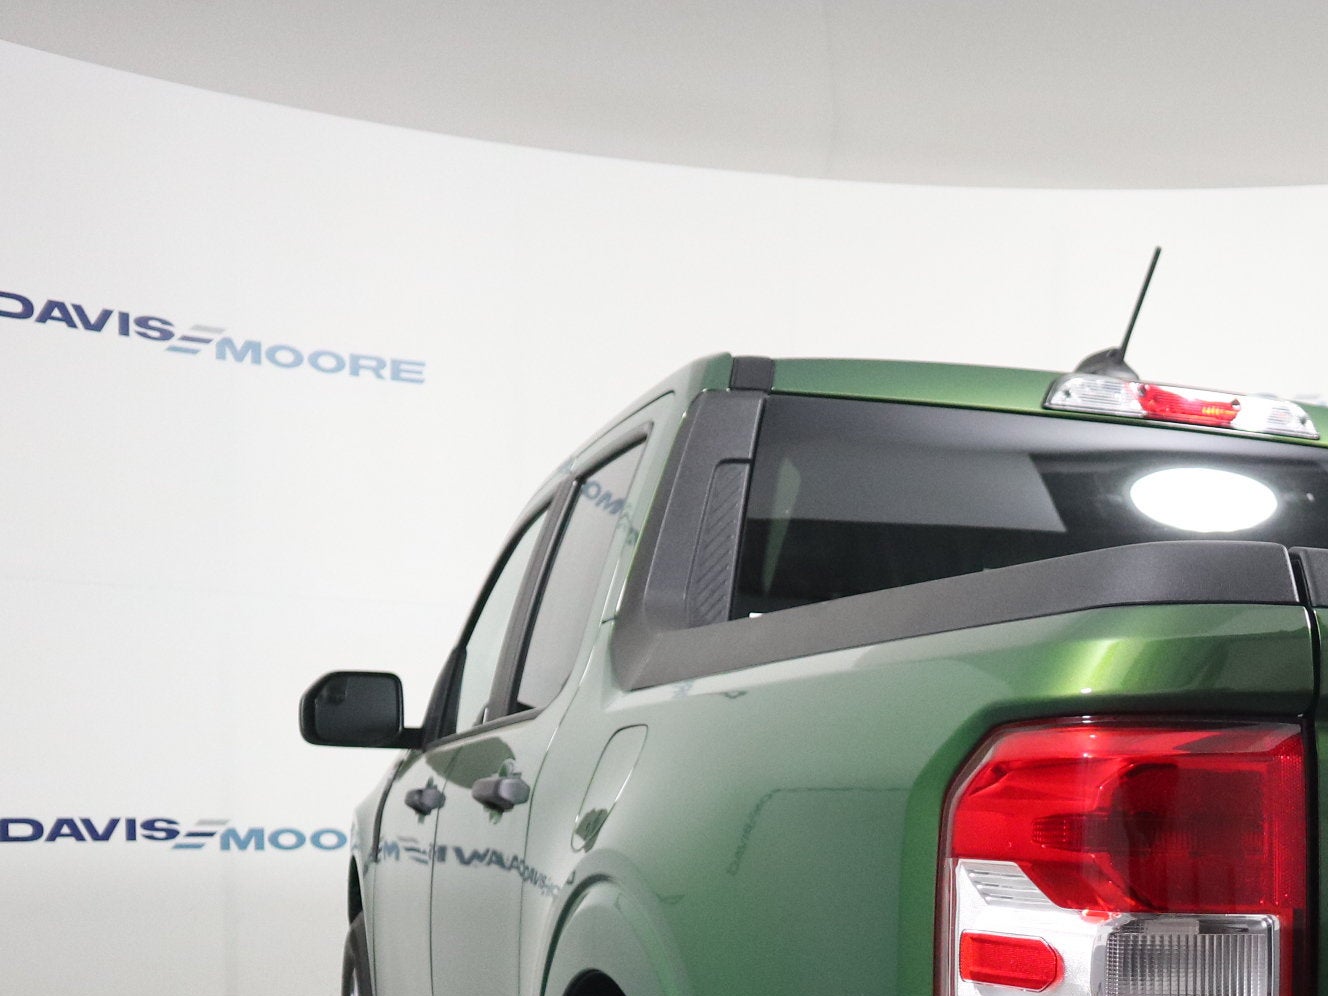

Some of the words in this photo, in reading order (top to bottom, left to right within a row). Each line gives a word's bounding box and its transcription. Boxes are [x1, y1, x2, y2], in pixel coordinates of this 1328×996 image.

[215, 337, 425, 384] MOORE
[0, 817, 180, 843] DAVIS
[219, 826, 347, 851] MOO
